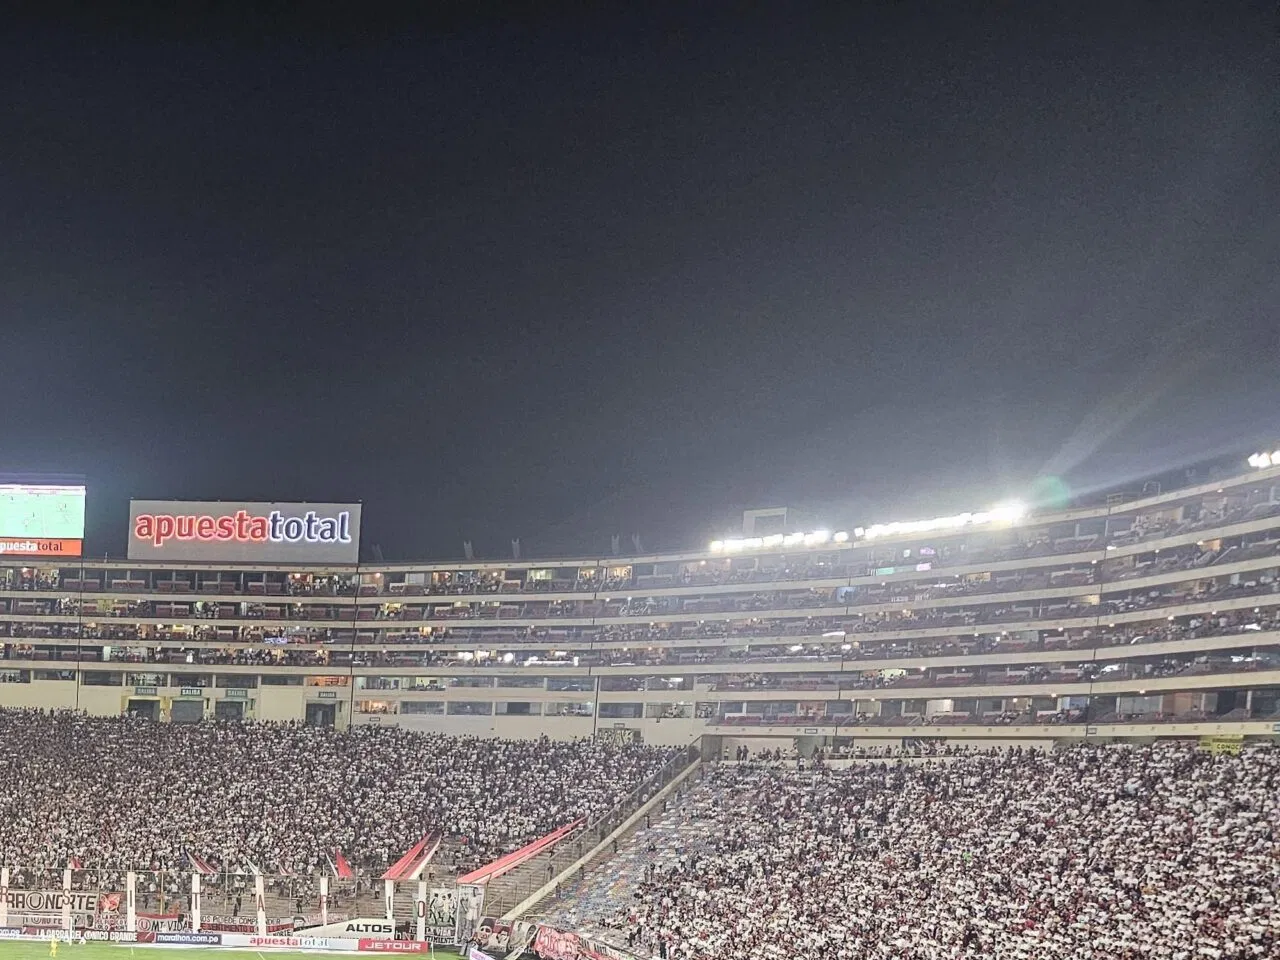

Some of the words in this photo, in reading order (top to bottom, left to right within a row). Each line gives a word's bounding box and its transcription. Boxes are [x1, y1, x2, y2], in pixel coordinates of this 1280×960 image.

[135, 510, 352, 547] apuestatotal
[346, 924, 392, 933] ALTOS
[157, 934, 219, 943] marathon.com.pe
[365, 942, 421, 950] JETOUR
